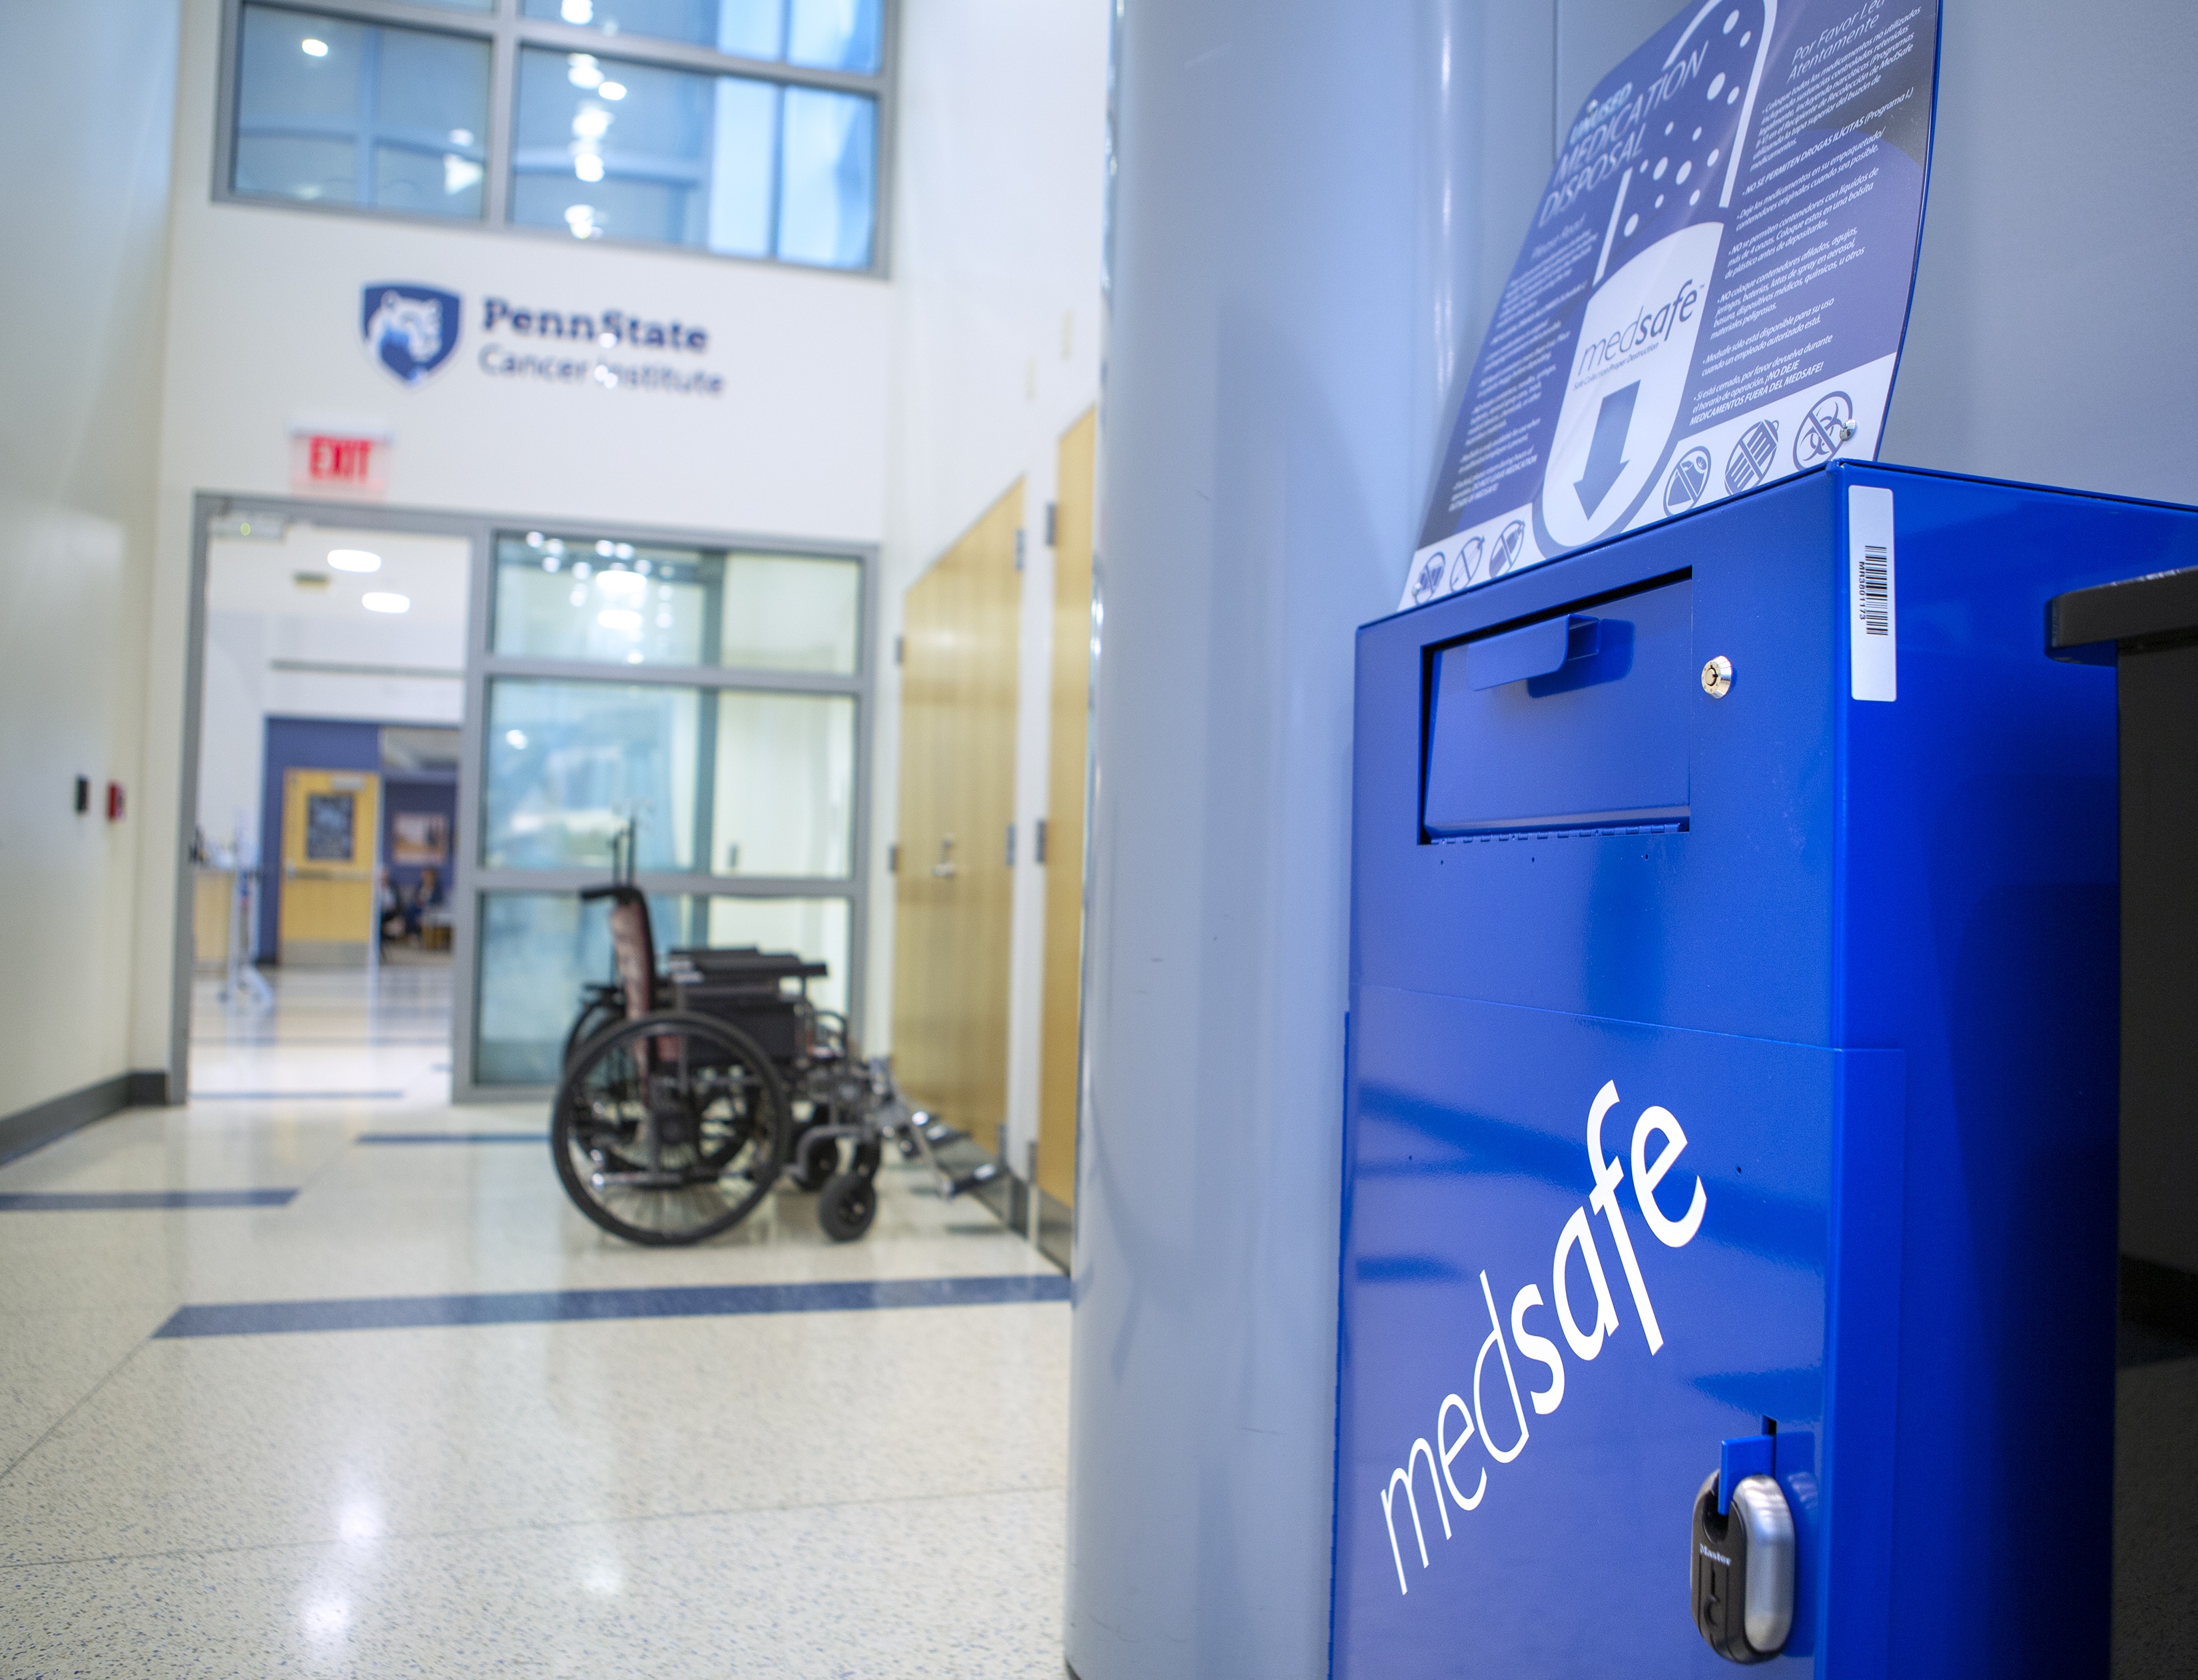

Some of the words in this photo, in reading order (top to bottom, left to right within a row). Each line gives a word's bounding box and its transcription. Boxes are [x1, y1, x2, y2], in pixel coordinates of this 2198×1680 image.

[1761, 98, 1795, 125] incluyendo
[1796, 76, 1830, 101] sustancias
[1831, 48, 1872, 79] controladas
[1874, 25, 1908, 51] retenidas
[1765, 91, 1791, 112] Coloque
[1791, 79, 1810, 95] todos
[1810, 72, 1820, 83] los
[1821, 39, 1872, 75] medicamentos
[1872, 31, 1883, 42] no
[1884, 6, 1922, 35] utilizados
[1786, 13, 1879, 84] Atentamente
[1792, 39, 1817, 65] Por
[1817, 11, 1859, 49] Favor
[1796, 85, 1832, 111] incluyendo
[1832, 61, 1869, 88] narcóticos
[1870, 32, 1914, 65] (Programas
[1553, 40, 1709, 189] MEDICATION
[1752, 136, 1783, 160] utilizando
[1784, 131, 1791, 140] la
[1791, 121, 1807, 135] tapa
[1807, 103, 1835, 125] superior
[1836, 93, 1848, 107] del
[1847, 81, 1870, 100] buzón
[1871, 75, 1881, 85] de
[1768, 130, 1777, 139] en
[1777, 123, 1784, 134] el
[1818, 98, 1827, 109] de
[1827, 72, 1868, 102] Recolección
[1869, 65, 1879, 76] de
[1879, 43, 1913, 69] MedSafe
[1538, 122, 1646, 228] DISPOSAL
[1745, 182, 1756, 195] NO
[1756, 176, 1765, 188] SE
[1765, 155, 1800, 181] PERMITEN
[1800, 135, 1832, 161] DROGAS
[1832, 117, 1864, 141] ILÍCITAS
[1864, 94, 1904, 123] (Programa
[1750, 139, 1796, 171] medicamentos.
[1727, 254, 1740, 267] más
[1741, 249, 1749, 259] de
[1750, 245, 1754, 254] 4
[1754, 236, 1774, 252] onzas.
[1776, 220, 1804, 240] Coloque
[1804, 210, 1822, 224] estos
[1822, 205, 1832, 214] en
[1832, 197, 1848, 209] una
[1848, 183, 1873, 201] bolsita
[1731, 242, 1742, 254] NO
[1742, 239, 1749, 248] se
[1748, 223, 1778, 246] permiten
[1779, 198, 1824, 227] contenedores
[1824, 190, 1838, 202] con
[1839, 173, 1868, 194] líquidos
[1868, 167, 1878, 178] de
[1736, 203, 1776, 230] contenedores
[1778, 183, 1810, 206] originales
[1810, 168, 1836, 187] cuando
[1837, 160, 1850, 173] sea
[1850, 145, 1878, 167] posible.
[1739, 205, 1753, 218] Deje
[1754, 200, 1763, 210] los
[1763, 172, 1810, 203] medicamentos
[1811, 166, 1820, 176] en
[1820, 161, 1830, 171] su
[1713, 312, 1734, 327] basura,
[1736, 292, 1773, 315] dispositivos
[1774, 278, 1802, 296] médicos,
[1804, 261, 1837, 283] químicos,
[1839, 256, 1844, 265] u
[1845, 246, 1864, 261] otros
[1714, 298, 1740, 318] jeringas,
[1742, 284, 1768, 301] baterías,
[1770, 274, 1787, 287] latas
[1787, 268, 1796, 279] de
[1797, 259, 1816, 275] spray
[1817, 254, 1826, 264] en
[1827, 237, 1855, 258] aerosol,
[1720, 290, 1731, 302] NO
[1731, 279, 1756, 296] coloque
[1756, 256, 1800, 283] contenedores
[1801, 241, 1829, 260] afilados,
[1832, 227, 1857, 245] agujas,
[1724, 269, 1732, 279] de
[1732, 256, 1757, 276] plástico
[1757, 246, 1775, 261] antes
[1776, 240, 1784, 251] de
[1785, 219, 1828, 246] depositarlos.
[1579, 278, 1698, 376] medsafe
[1701, 360, 1724, 376] cuando
[1724, 356, 1734, 365] un
[1734, 341, 1766, 361] empleado
[1766, 324, 1804, 346] autorizado
[1804, 314, 1820, 328] está.
[1705, 345, 1731, 363] Medsafe
[1731, 339, 1744, 351] sólo
[1745, 331, 1759, 344] está
[1759, 316, 1794, 338] disponible
[1793, 308, 1811, 324] para
[1811, 304, 1820, 314] su
[1820, 298, 1834, 309] uso
[1710, 319, 1742, 339] materiales
[1742, 302, 1776, 326] peligrosos.
[478, 343, 587, 380] Cancer
[1690, 396, 1744, 425] MEDICAMENTOS
[1744, 385, 1768, 402] FUERA
[1768, 379, 1782, 392] DEL
[1784, 362, 1823, 385] MEDSAFE!
[1692, 403, 1699, 413] el
[1698, 395, 1721, 410] horario
[1721, 390, 1730, 400] de
[1730, 377, 1763, 397] operación.
[1780, 360, 1799, 375] DEJE
[1702, 385, 1716, 398] está
[1716, 375, 1740, 392] cerrado,
[1740, 370, 1754, 382] por
[1754, 362, 1772, 375] favor
[1772, 348, 1803, 366] devuelva
[1804, 335, 1832, 352] durante
[308, 436, 372, 484] EXIT
[1380, 1079, 1707, 1595] medsafe
[1699, 1543, 1731, 1567] Master
